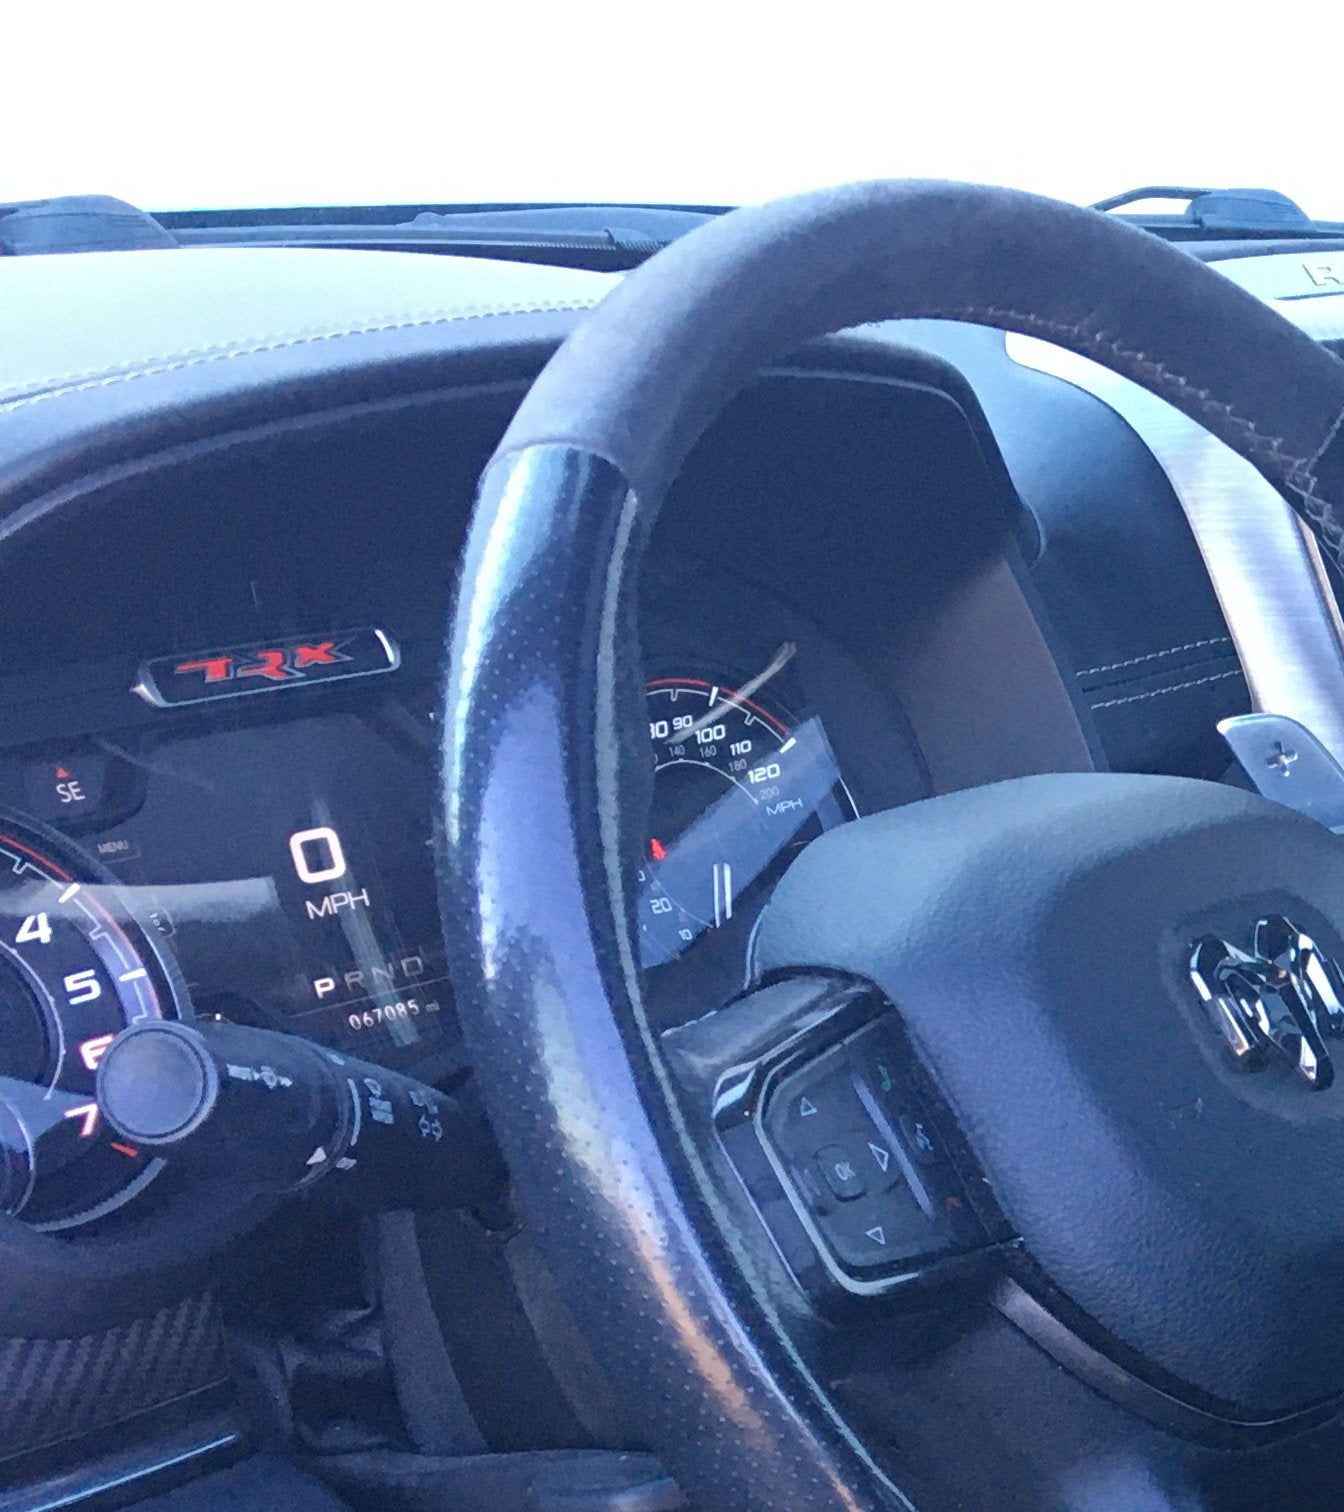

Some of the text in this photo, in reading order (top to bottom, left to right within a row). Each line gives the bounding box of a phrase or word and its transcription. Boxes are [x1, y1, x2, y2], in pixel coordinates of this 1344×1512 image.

[173, 636, 355, 684] TRX
[672, 715, 693, 731] 90
[695, 724, 726, 744] 100
[729, 740, 752, 756] 110
[748, 763, 781, 784] 120
[56, 780, 86, 802] SE
[765, 797, 804, 817] MPH
[97, 839, 130, 854] MENU
[289, 827, 346, 884] 0
[305, 888, 370, 919] MPH
[649, 897, 673, 914] 20
[15, 912, 53, 944] 4
[63, 968, 101, 1005] 5
[313, 977, 336, 999] P
[344, 970, 367, 992] R
[401, 956, 424, 977] D
[348, 998, 421, 1031] 067085
[63, 1103, 99, 1138] 7
